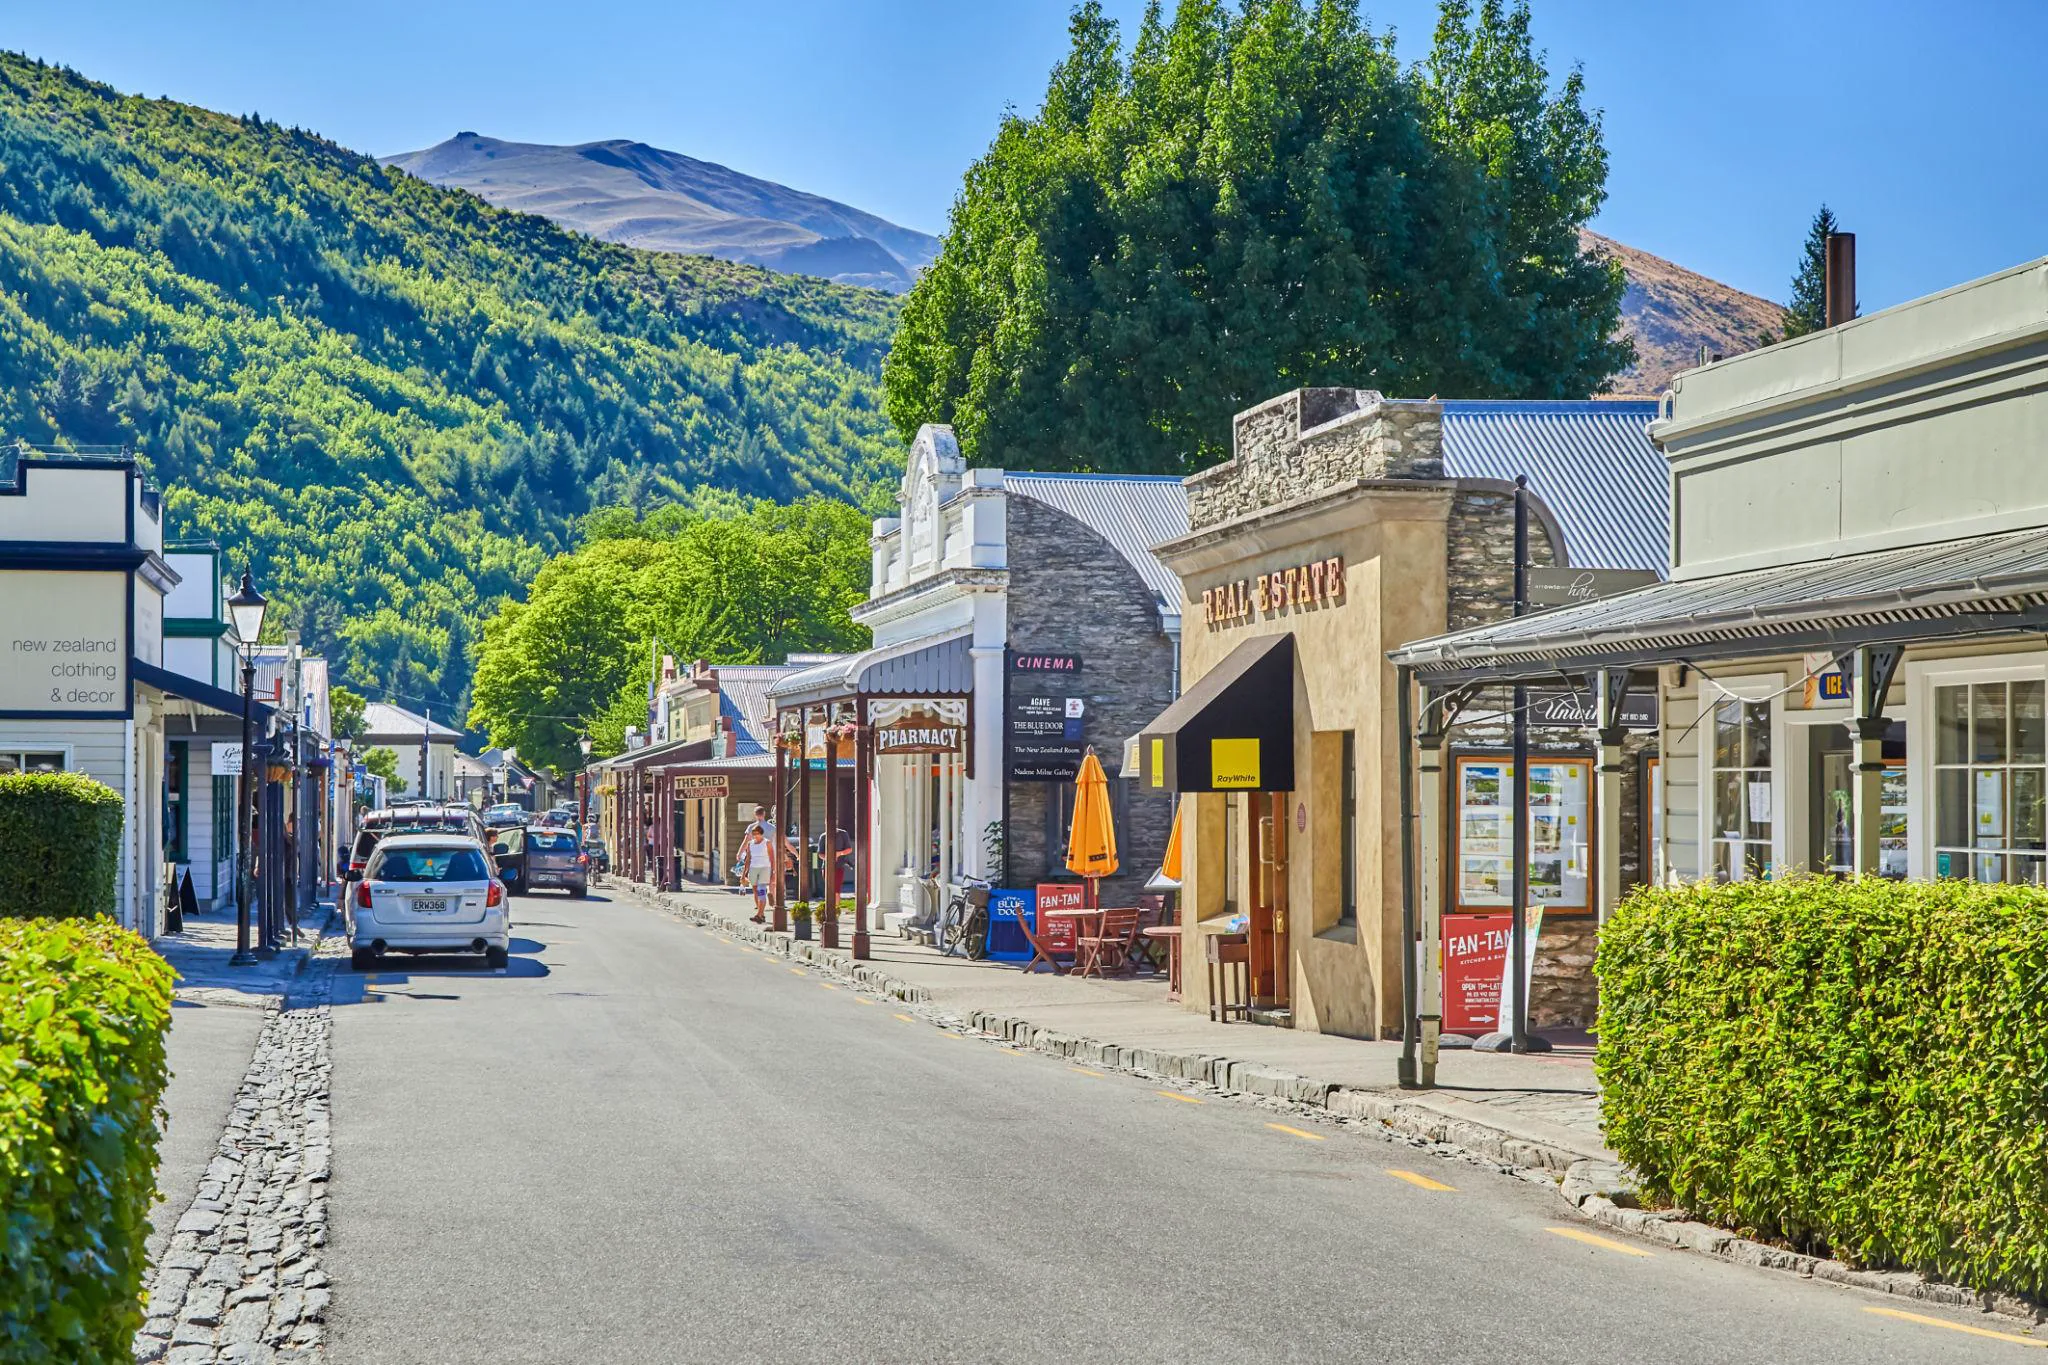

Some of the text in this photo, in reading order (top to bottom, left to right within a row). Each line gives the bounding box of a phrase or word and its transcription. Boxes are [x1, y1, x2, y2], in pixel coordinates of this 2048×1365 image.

[1202, 556, 1343, 625] REAL ESTATE
[12, 637, 117, 653] new zealand
[1017, 656, 1074, 670] CINEMA
[51, 661, 117, 681] clothing
[50, 687, 116, 703] & decor
[1030, 697, 1051, 706] AGAVE
[1013, 721, 1027, 730] THE
[1027, 721, 1044, 730] BLUE
[1044, 721, 1064, 731] DOOR
[879, 728, 958, 751] PHARMACY
[675, 776, 725, 789] THE SHED
[997, 900, 1025, 909] BLUE
[1040, 892, 1081, 908] FAN-TAN
[1460, 957, 1486, 965] KITCHEN
[1461, 983, 1476, 991] OPEN
